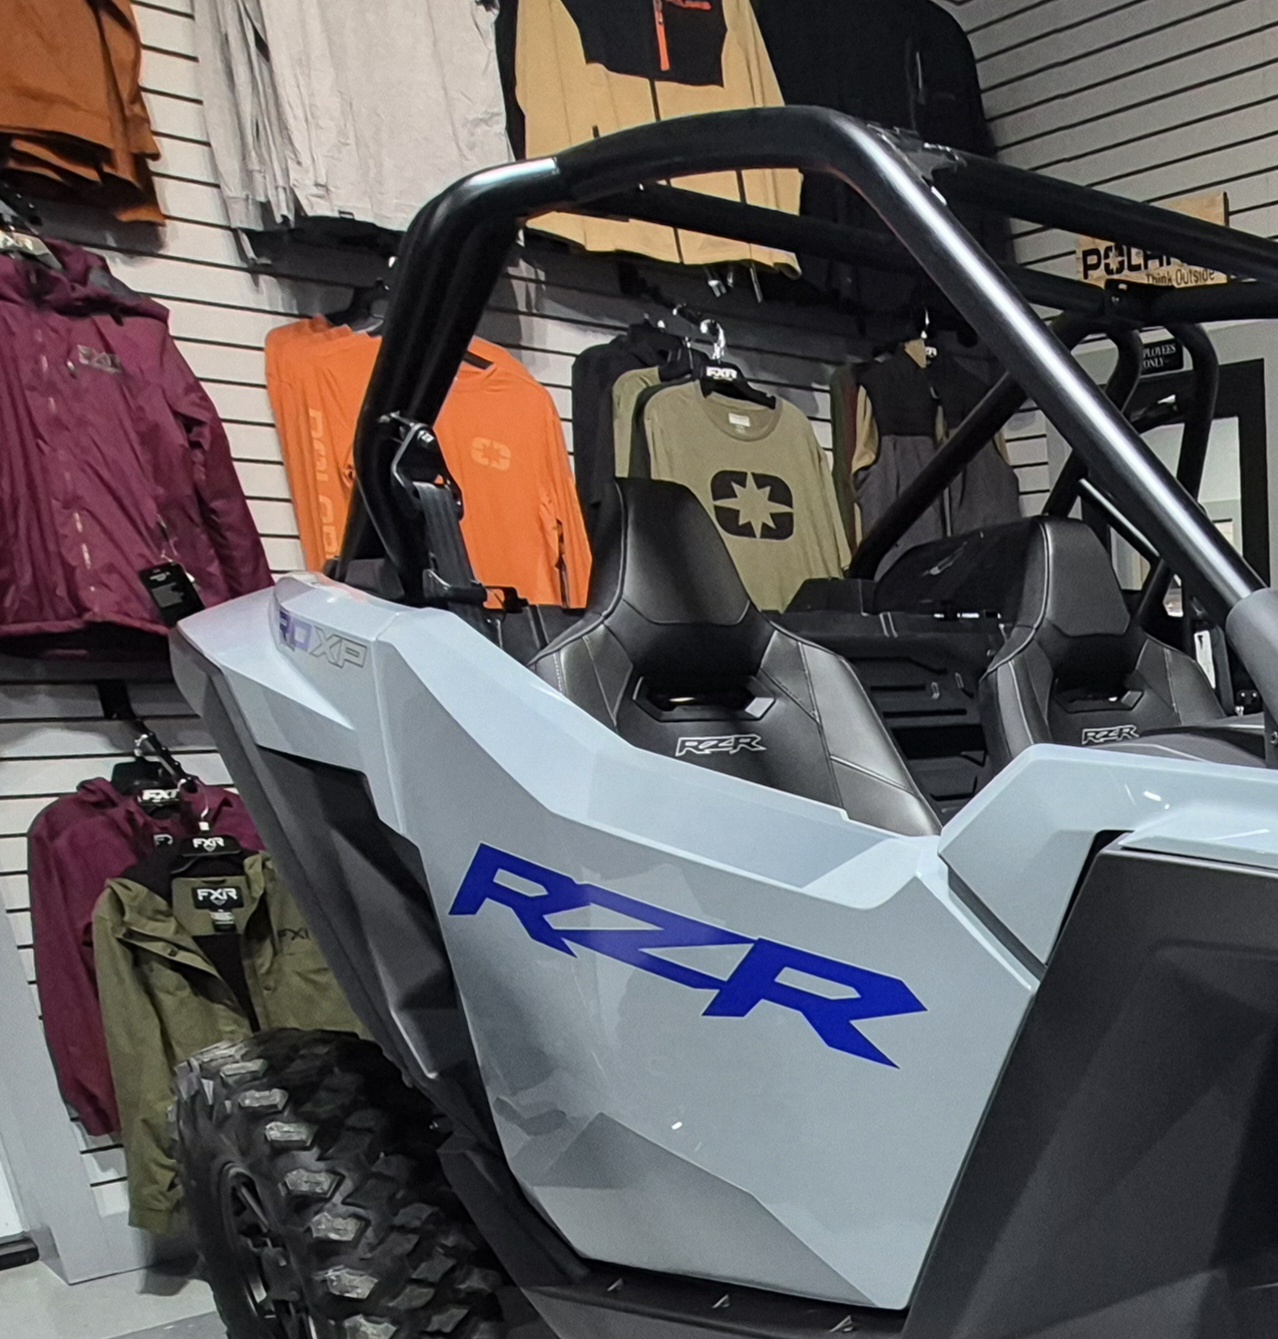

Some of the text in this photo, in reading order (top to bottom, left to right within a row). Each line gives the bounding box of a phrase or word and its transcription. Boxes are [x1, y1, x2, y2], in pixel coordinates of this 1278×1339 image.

[1175, 268, 1215, 287] Outside
[1143, 356, 1165, 369] ONLY
[1081, 724, 1140, 745] RZR
[675, 733, 768, 757] RZR
[192, 836, 225, 850] FXR
[196, 887, 238, 902] FXR
[448, 843, 928, 1069] RZR
